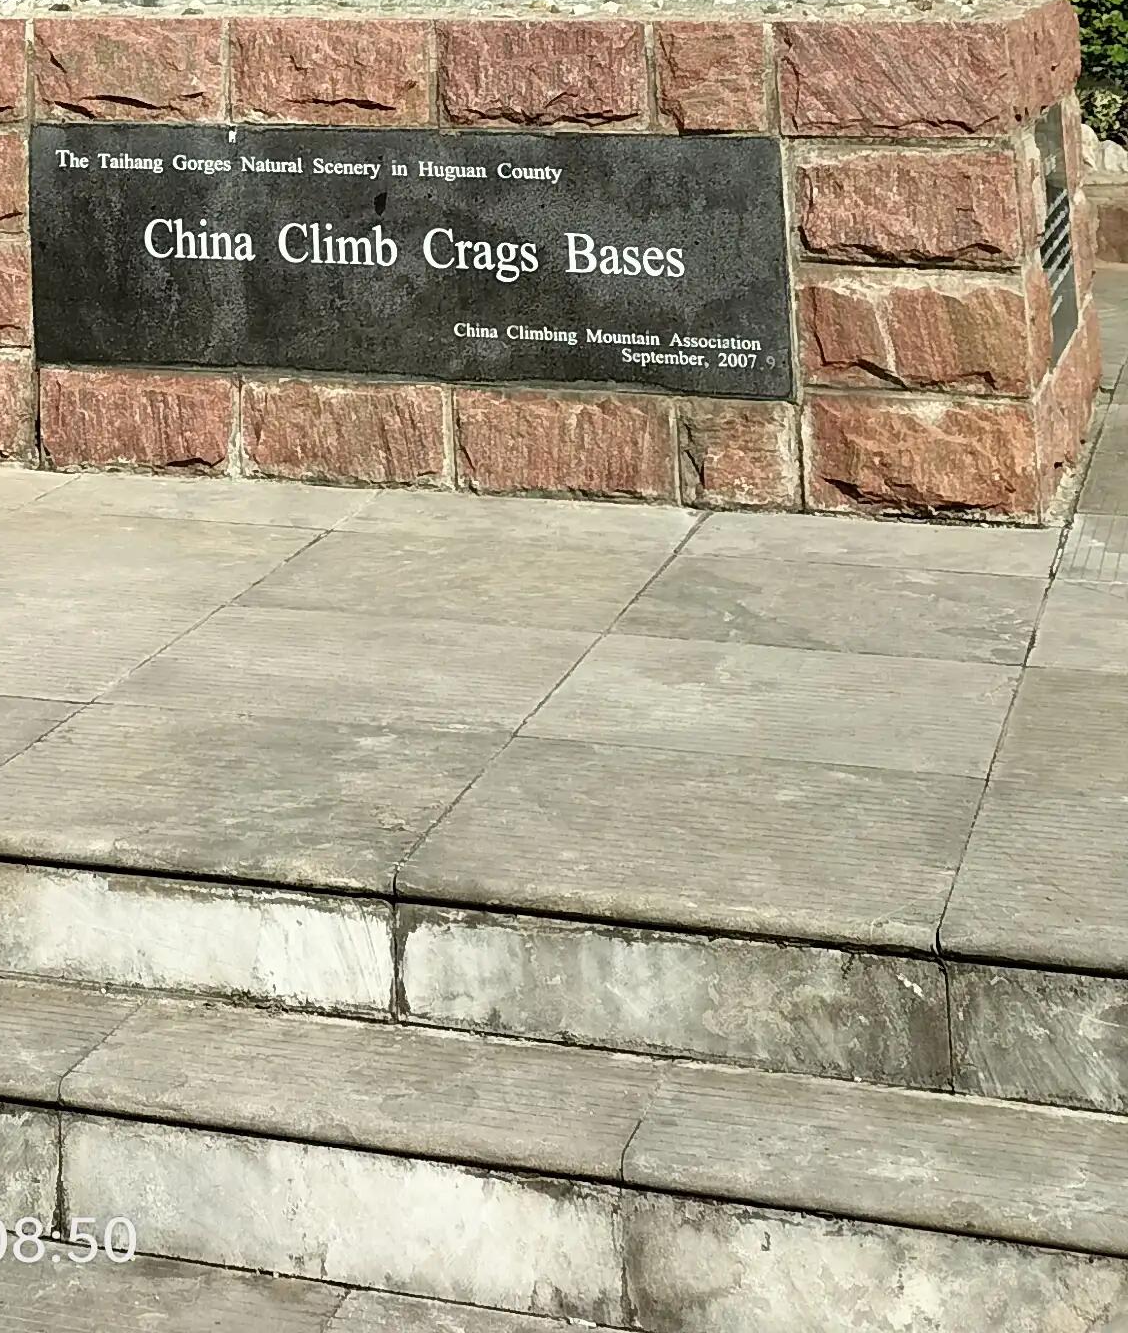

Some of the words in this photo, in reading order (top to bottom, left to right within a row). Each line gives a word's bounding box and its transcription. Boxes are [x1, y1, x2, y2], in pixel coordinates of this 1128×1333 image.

[55, 149, 90, 169] The
[97, 153, 164, 174] Taihang
[172, 154, 232, 175] Gorges
[240, 156, 303, 174] Natural
[313, 158, 381, 179] Scenery
[391, 159, 408, 177] in
[418, 161, 488, 181] Huguan
[497, 163, 563, 184] County
[144, 218, 256, 262] China
[278, 222, 398, 268] Climb
[423, 227, 539, 283] Crags
[564, 232, 686, 278] Bases
[453, 322, 499, 339] China
[506, 325, 578, 346] Climbing
[586, 328, 661, 347] Mountain
[669, 332, 762, 351] Association
[622, 347, 710, 369] September,
